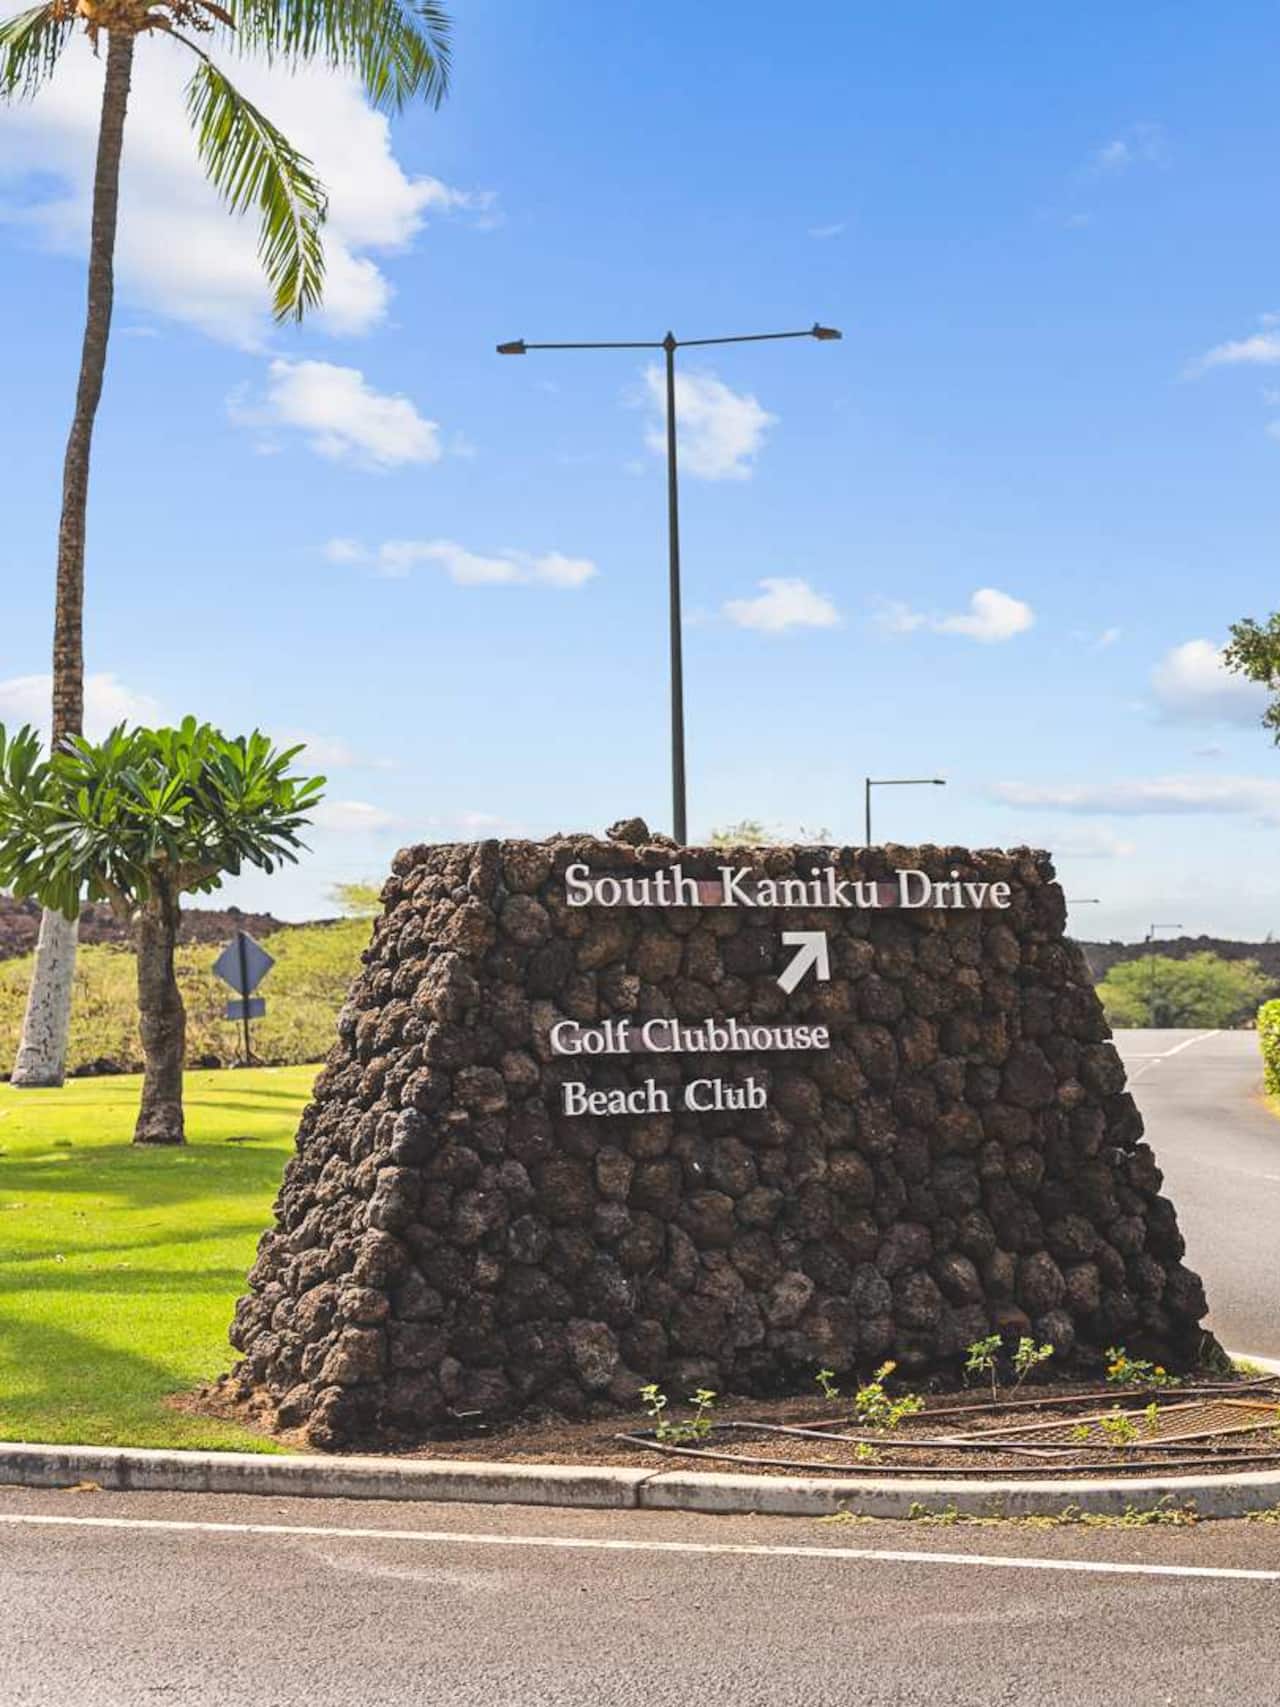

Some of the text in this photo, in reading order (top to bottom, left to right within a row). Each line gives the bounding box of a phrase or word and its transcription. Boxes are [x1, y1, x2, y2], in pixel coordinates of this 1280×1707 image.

[565, 864, 1011, 909] South Kaniku Drive
[551, 1018, 829, 1055] Golf Clubhouse
[562, 1077, 768, 1116] Beach Club
